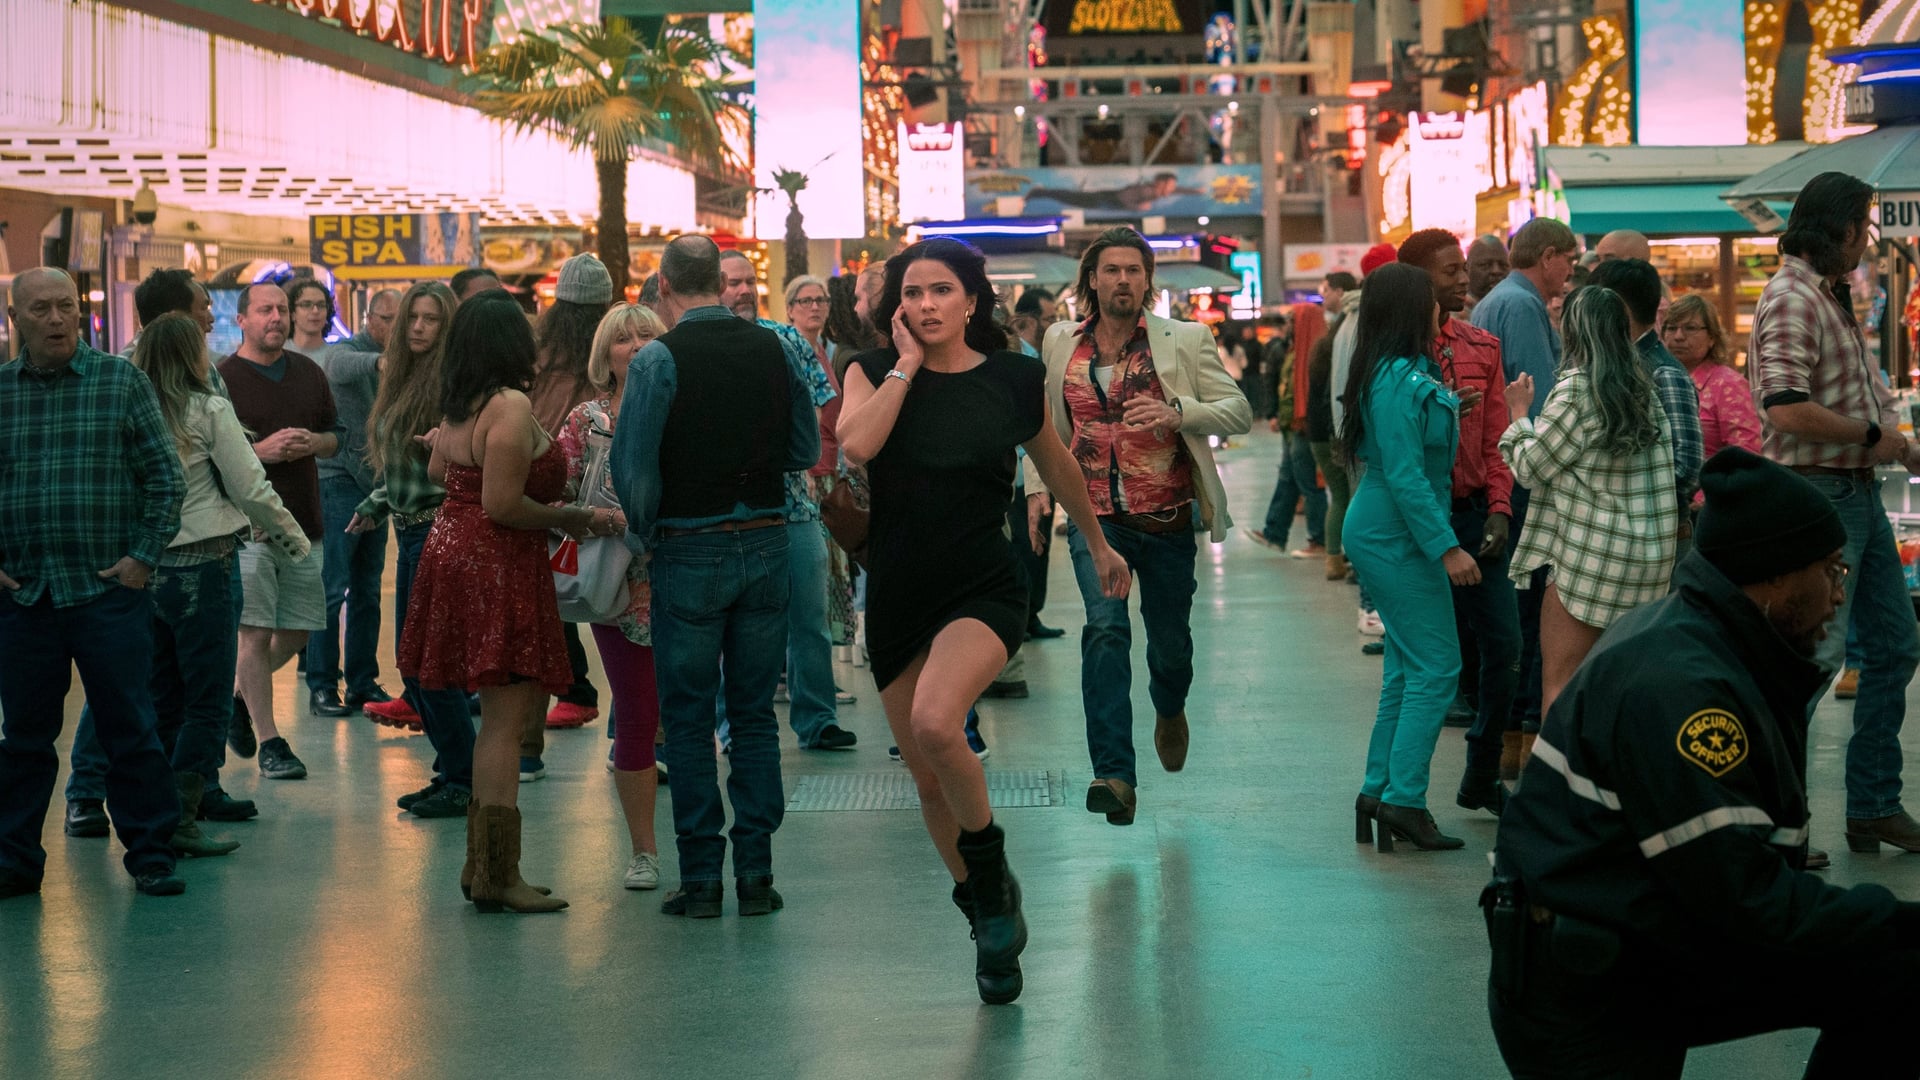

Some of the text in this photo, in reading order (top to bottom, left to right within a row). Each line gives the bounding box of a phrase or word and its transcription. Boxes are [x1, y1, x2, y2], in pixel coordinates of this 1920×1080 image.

[314, 215, 412, 239] FISH
[322, 240, 406, 264] SPA
[1687, 715, 1742, 741] SECURITY
[1690, 741, 1740, 766] OFFICER
